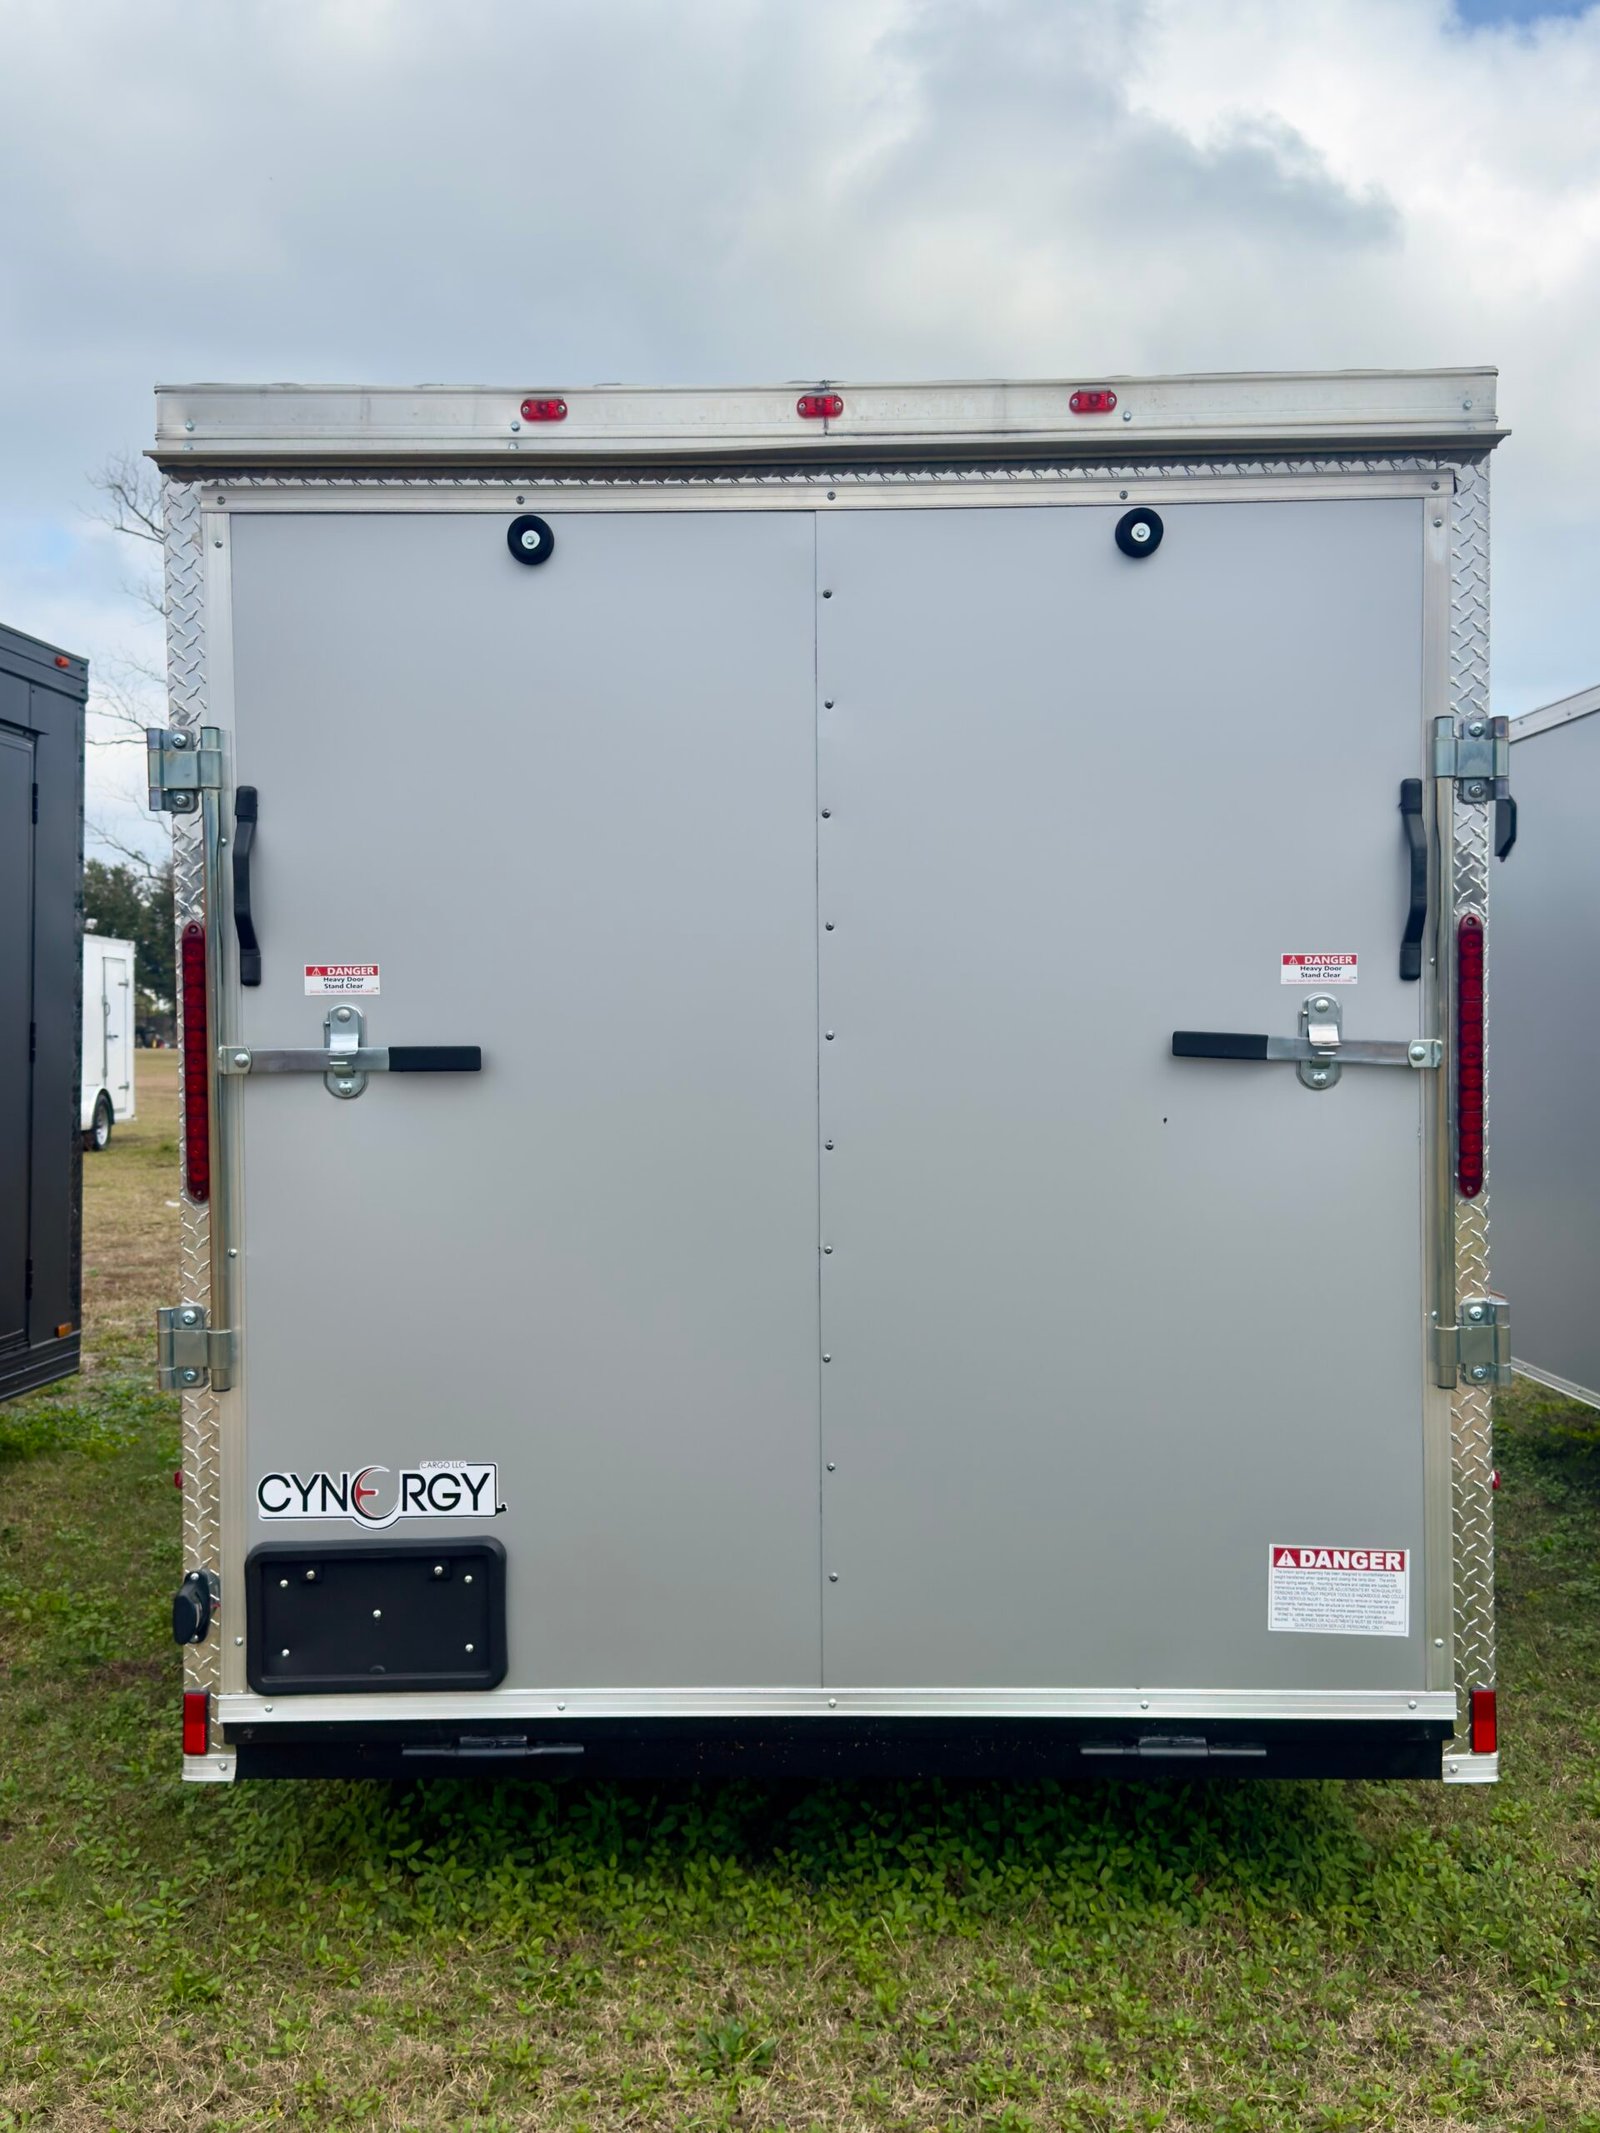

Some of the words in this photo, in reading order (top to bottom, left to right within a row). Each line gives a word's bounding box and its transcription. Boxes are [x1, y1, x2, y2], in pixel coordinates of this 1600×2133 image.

[1304, 956, 1353, 964] DANGER
[327, 967, 374, 975] DANGER
[420, 1461, 451, 1469] CARGO
[451, 1461, 466, 1469] LLC
[257, 1466, 491, 1520] CYNERGY
[1300, 1550, 1402, 1571] DANGER
